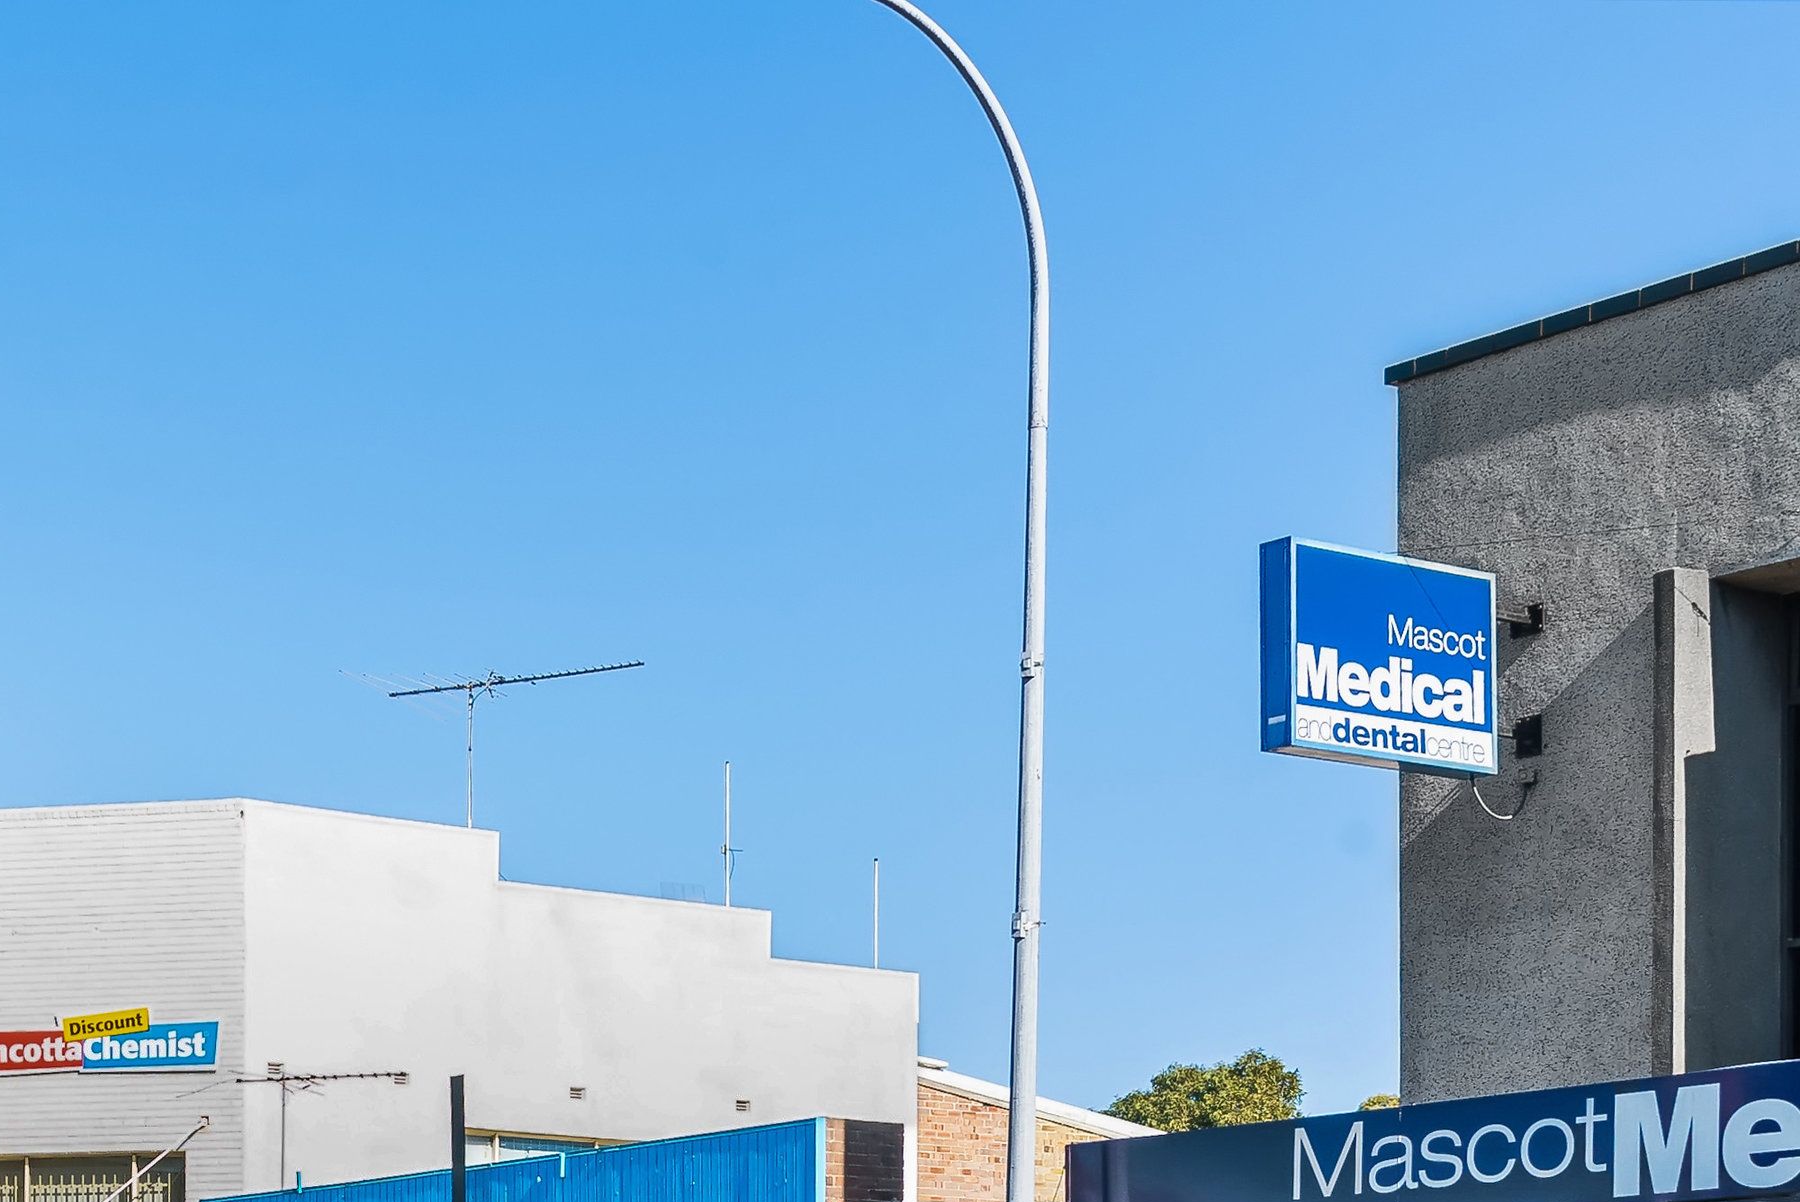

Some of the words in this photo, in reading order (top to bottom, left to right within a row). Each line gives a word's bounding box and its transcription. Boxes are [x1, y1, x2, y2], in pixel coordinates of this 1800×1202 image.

[1388, 613, 1486, 661] Mascot
[1297, 643, 1484, 725] Medical
[69, 1012, 143, 1036] Discount
[1293, 1096, 1608, 1200] Mascot
